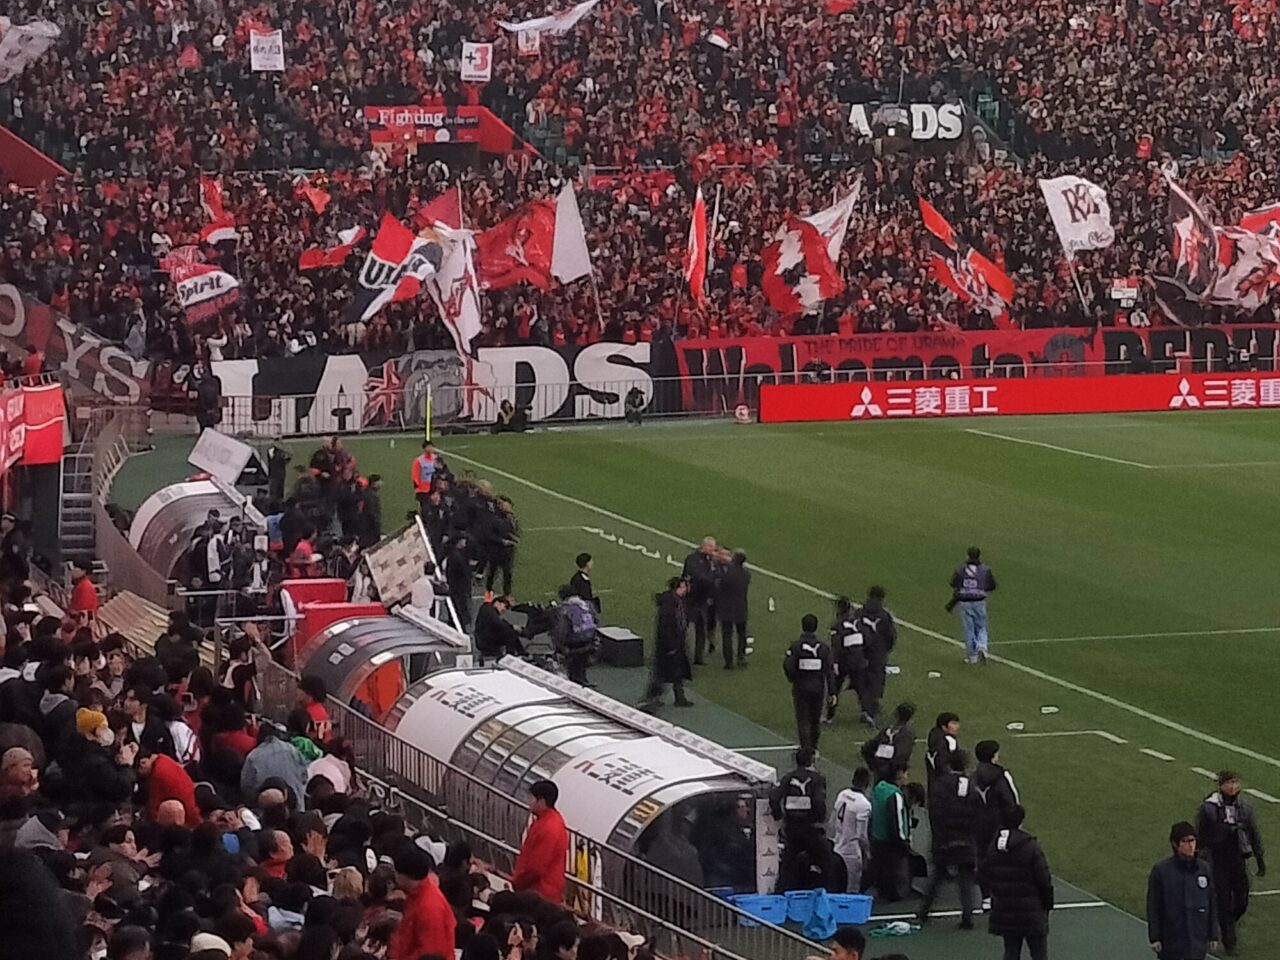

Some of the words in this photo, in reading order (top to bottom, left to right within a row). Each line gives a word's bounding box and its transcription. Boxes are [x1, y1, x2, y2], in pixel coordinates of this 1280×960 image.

[378, 109, 443, 126] Fighting
[180, 275, 223, 301] Spirit
[886, 385, 999, 415] 三菱重工
